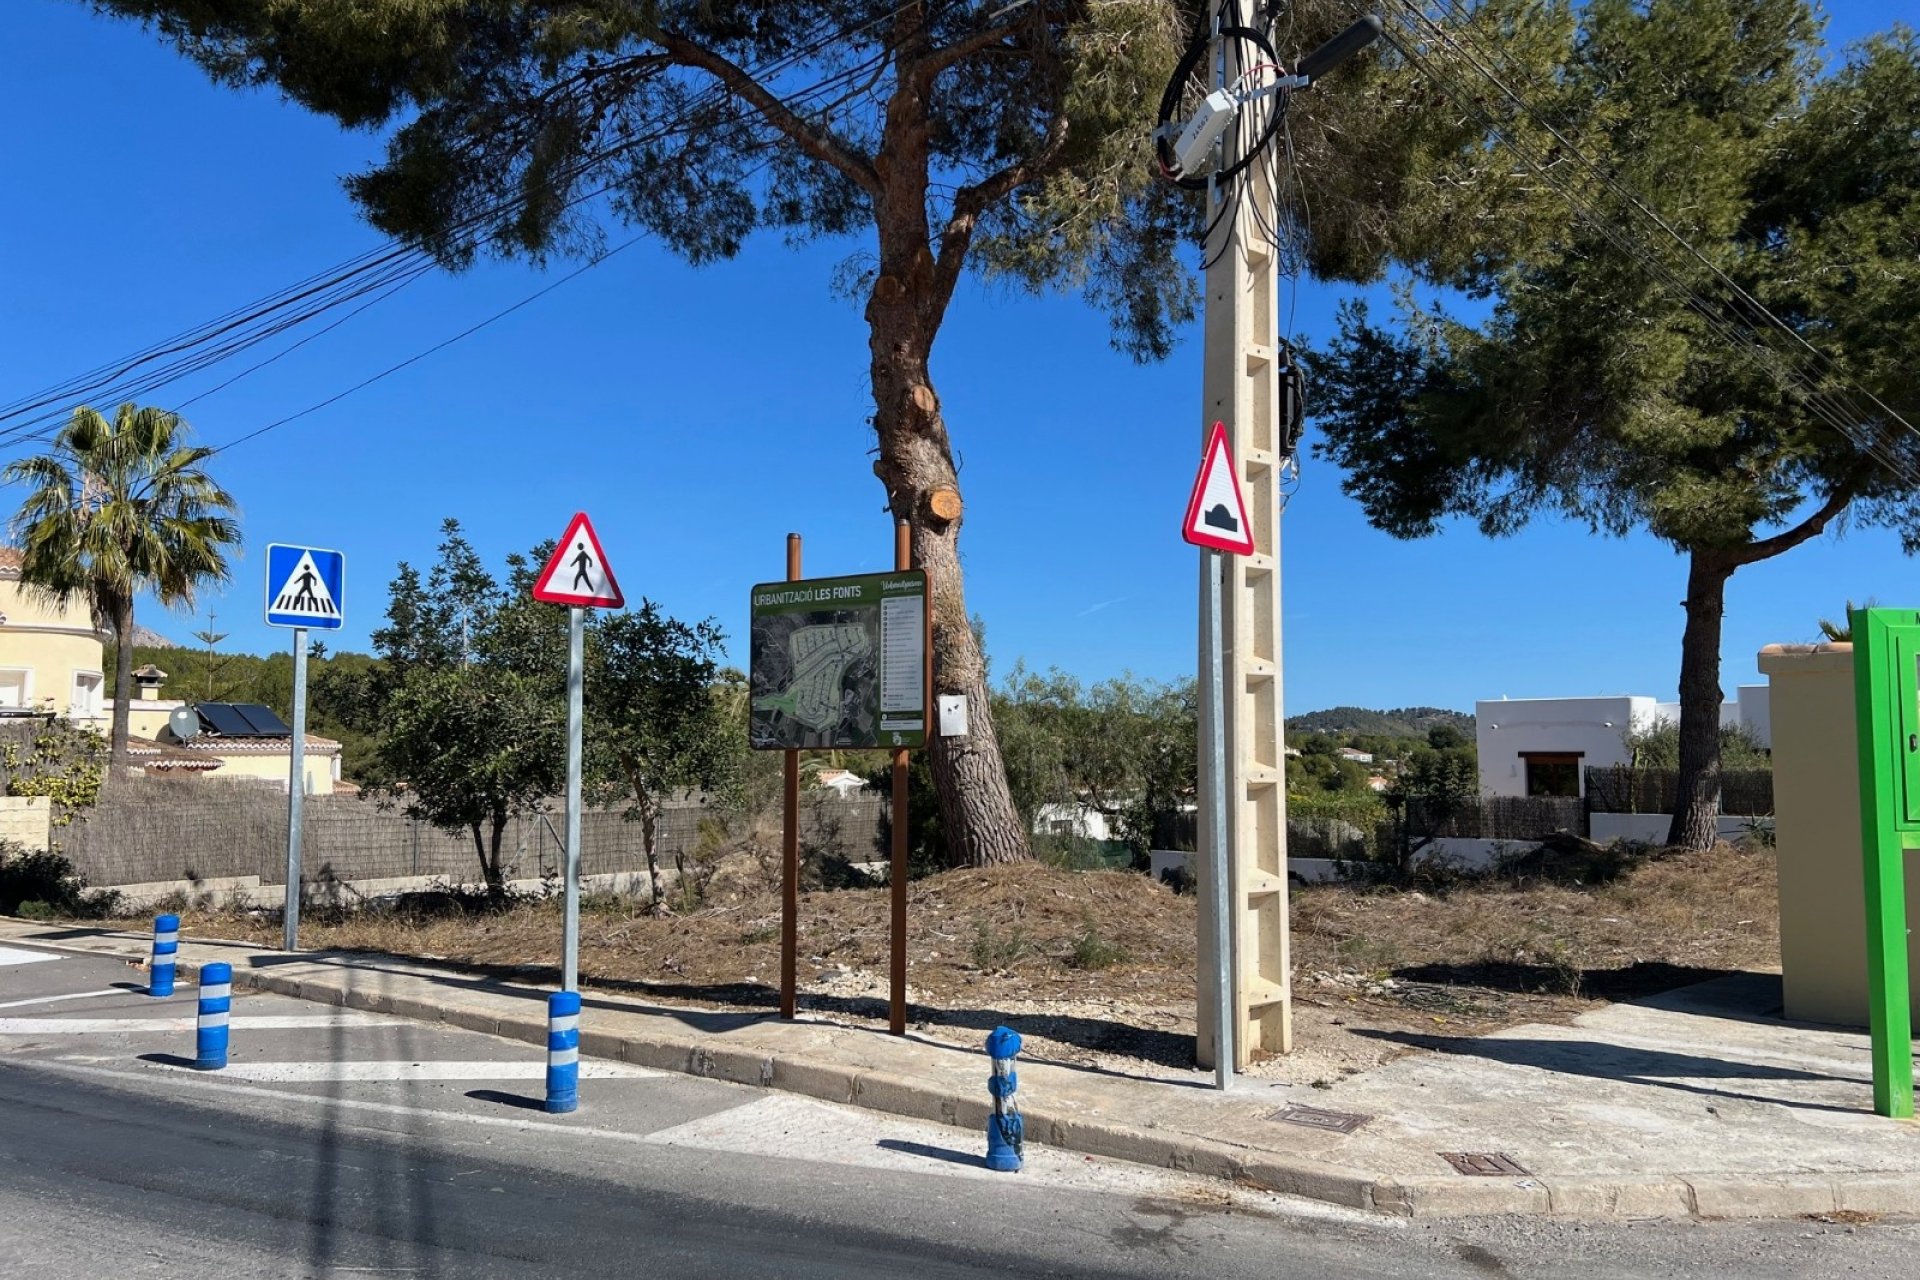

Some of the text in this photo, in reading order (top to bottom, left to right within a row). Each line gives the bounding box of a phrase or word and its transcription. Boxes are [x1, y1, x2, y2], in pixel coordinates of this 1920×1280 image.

[754, 585, 862, 606] URBANITZACIÓ LES FONTS
